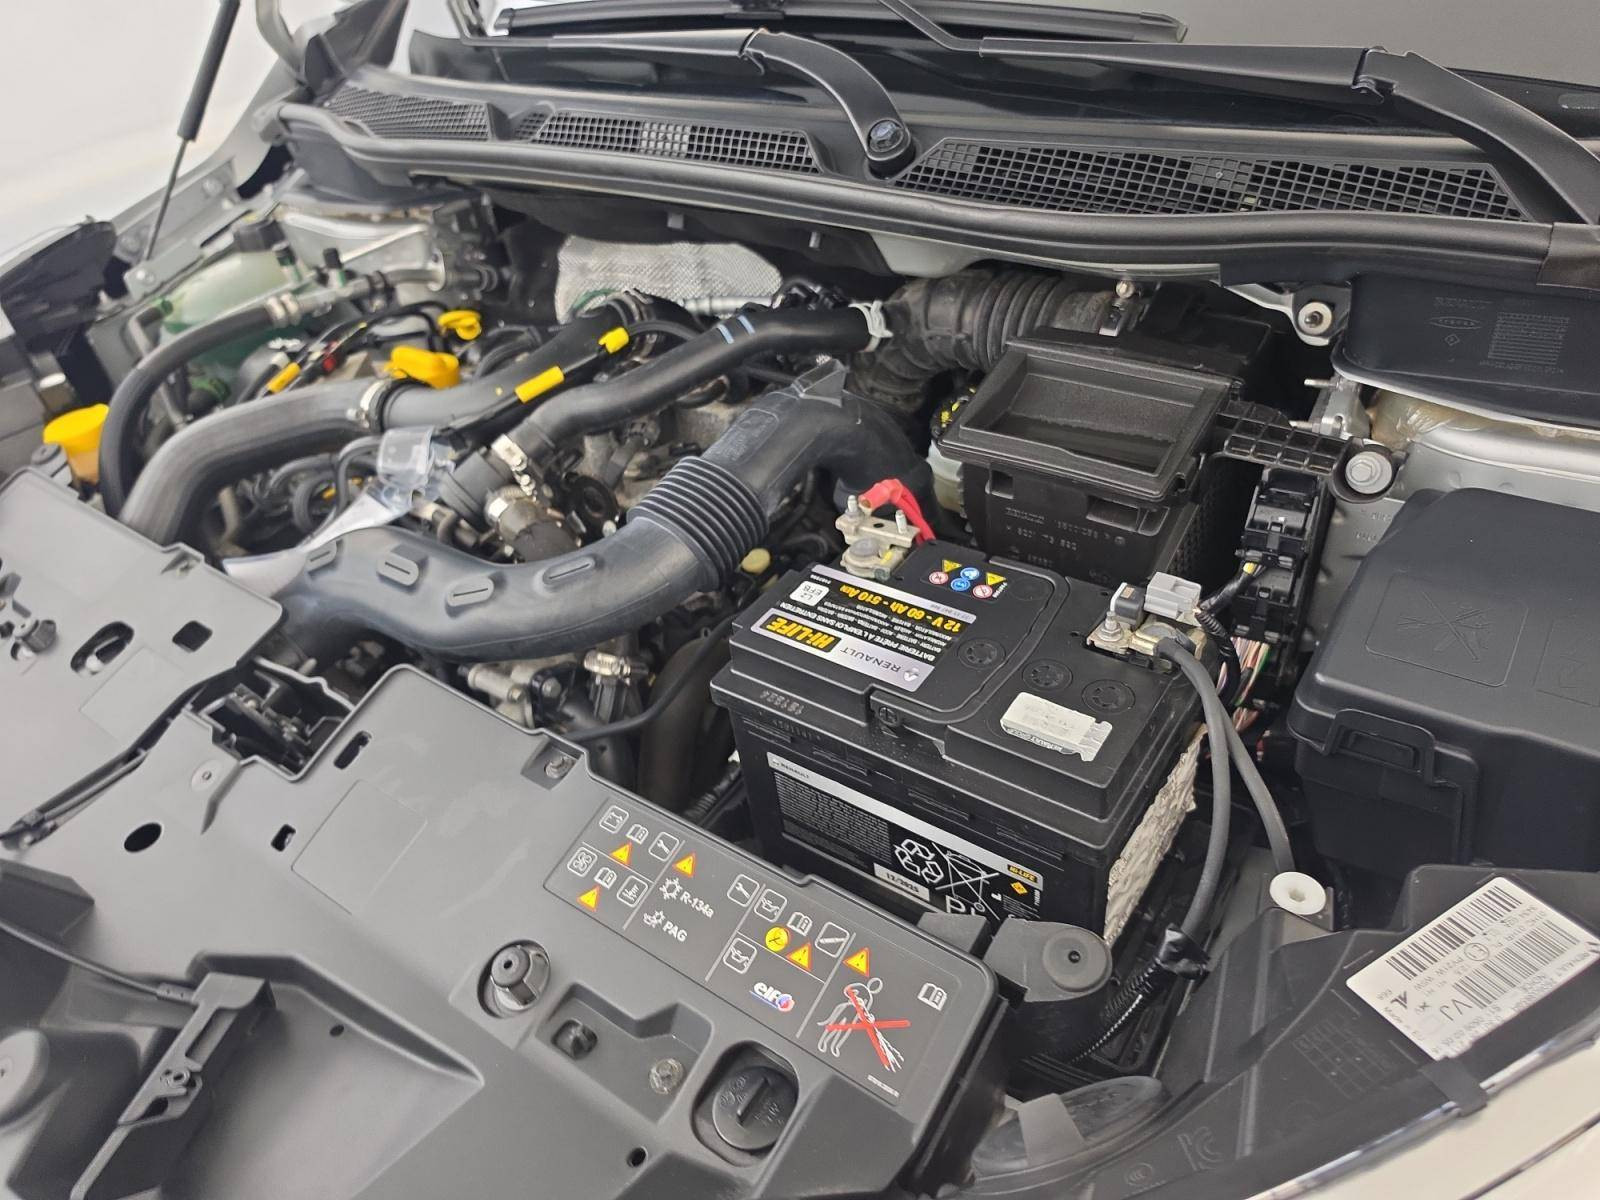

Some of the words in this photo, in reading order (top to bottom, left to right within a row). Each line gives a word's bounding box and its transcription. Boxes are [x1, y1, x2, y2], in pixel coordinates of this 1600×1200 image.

[803, 584, 822, 595] EFB
[857, 591, 881, 604] 510
[780, 602, 816, 618] ENTRETIEN
[890, 601, 908, 613] Ah
[907, 607, 924, 619] 60
[816, 614, 835, 625] SANS
[931, 616, 943, 627] V
[943, 619, 960, 631] 12
[873, 635, 898, 648] PRÊTE
[898, 644, 934, 661] BATTERIE
[840, 647, 900, 672] RENAULT
[680, 888, 716, 918] R-134a
[663, 919, 689, 942] PAG
[1439, 999, 1472, 1020] VJ
